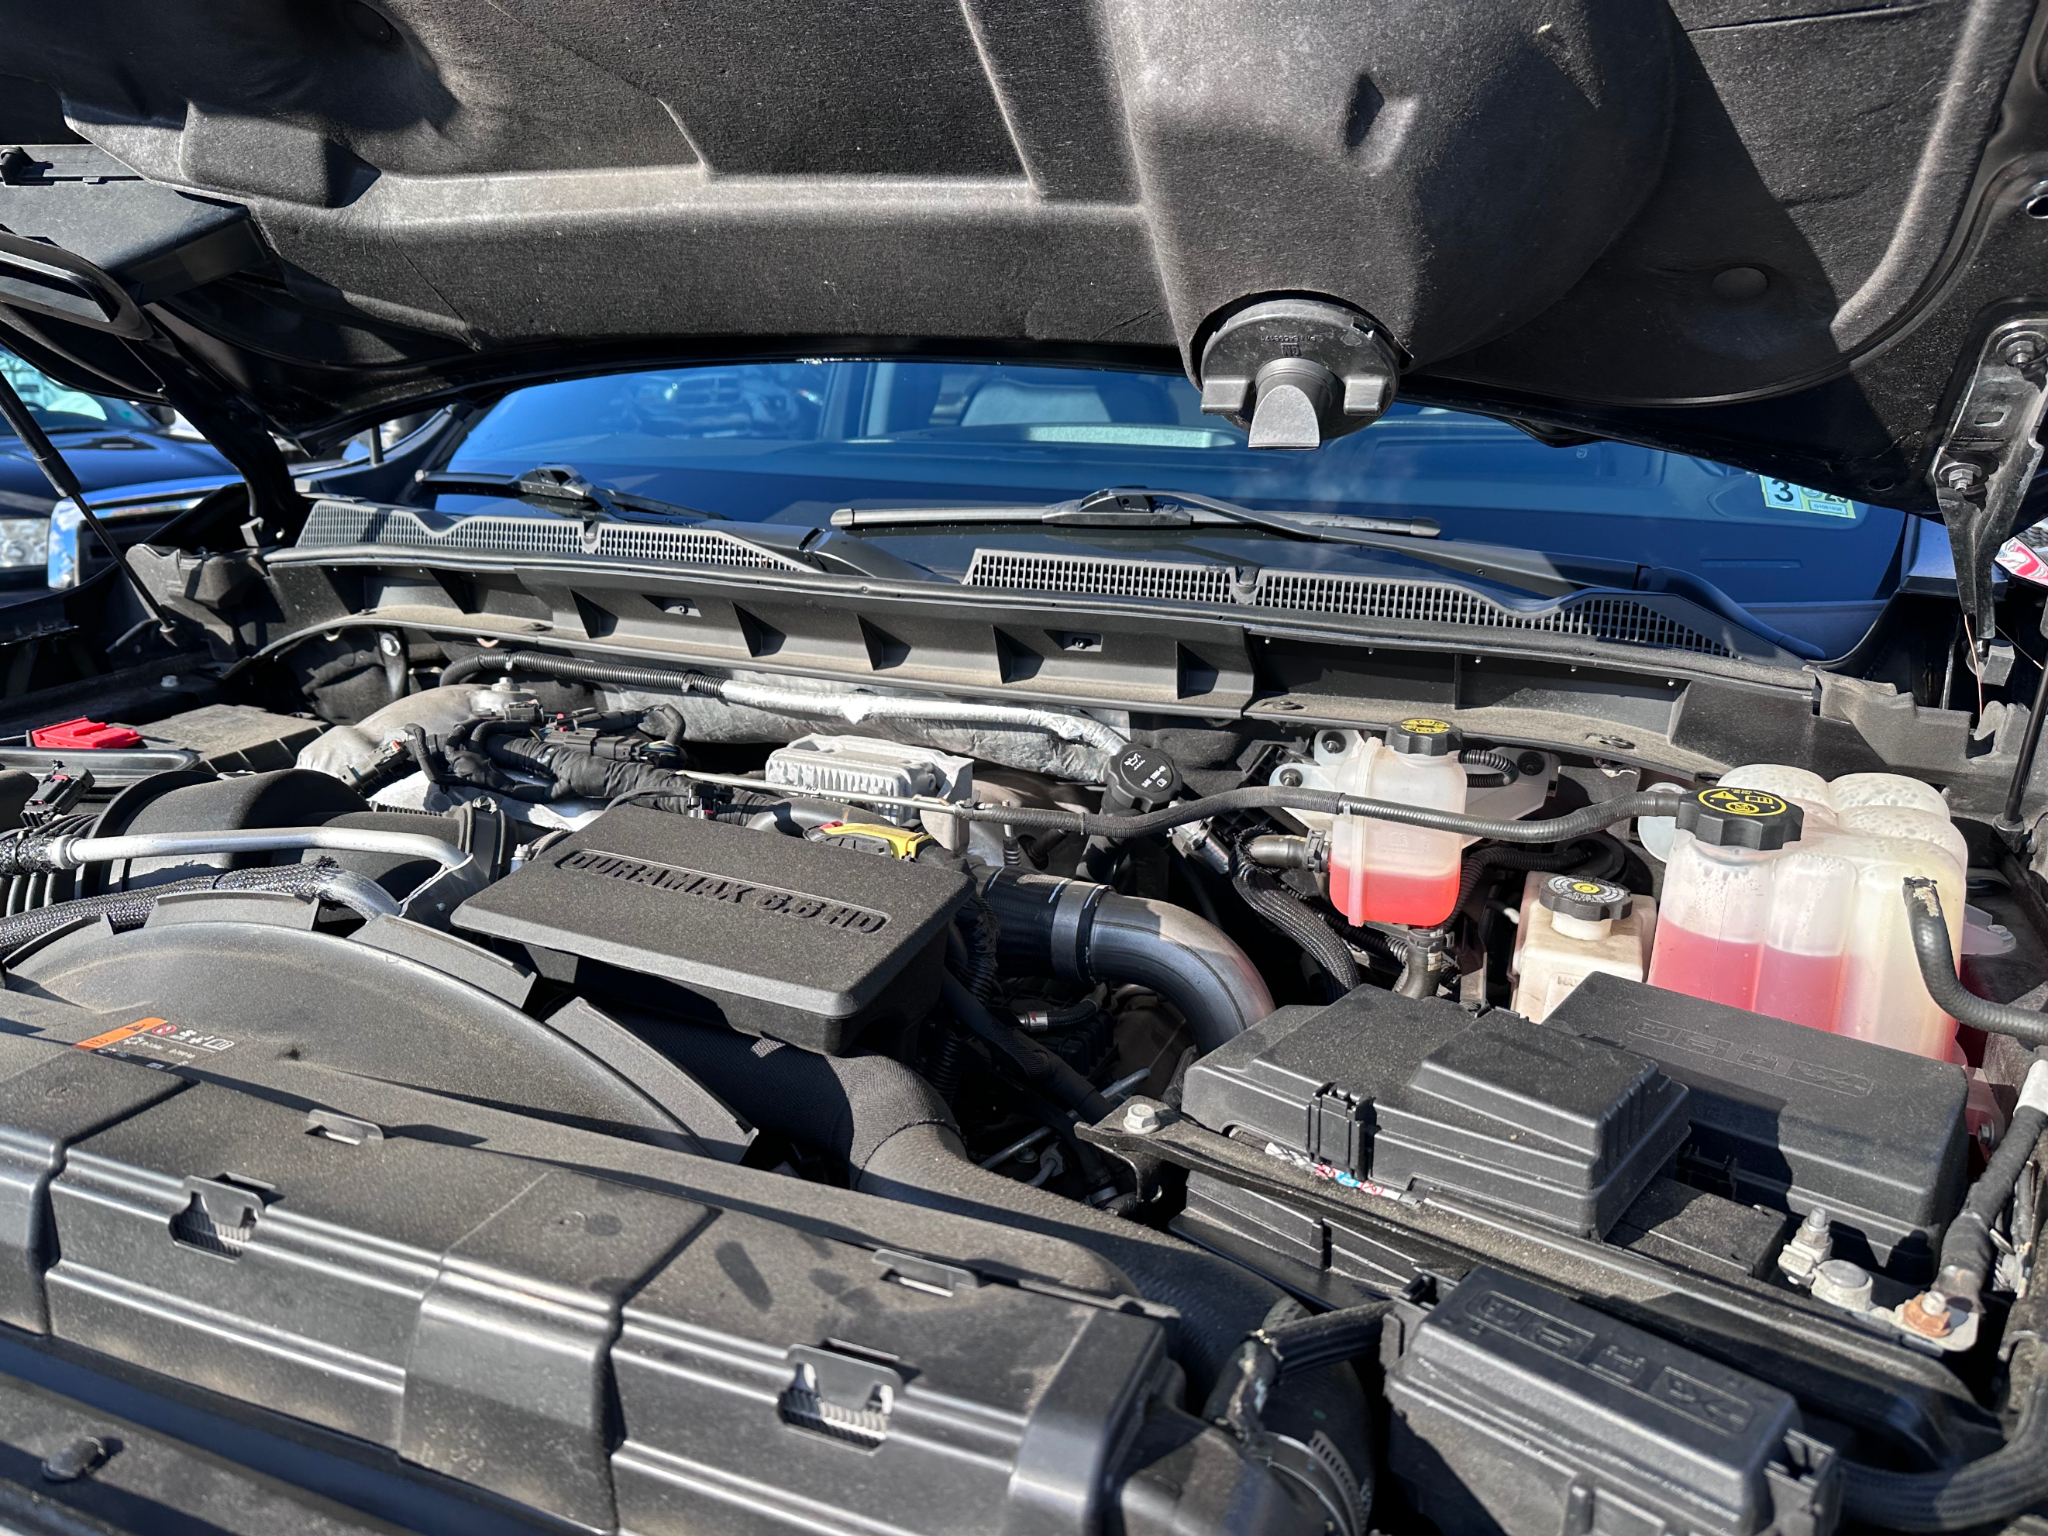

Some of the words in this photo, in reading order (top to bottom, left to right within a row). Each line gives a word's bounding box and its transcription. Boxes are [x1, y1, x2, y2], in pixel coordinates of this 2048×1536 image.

[1772, 479, 1794, 502] 3
[570, 851, 756, 904] DURAMAX
[756, 891, 828, 919] 6.6
[825, 903, 888, 934] HD
